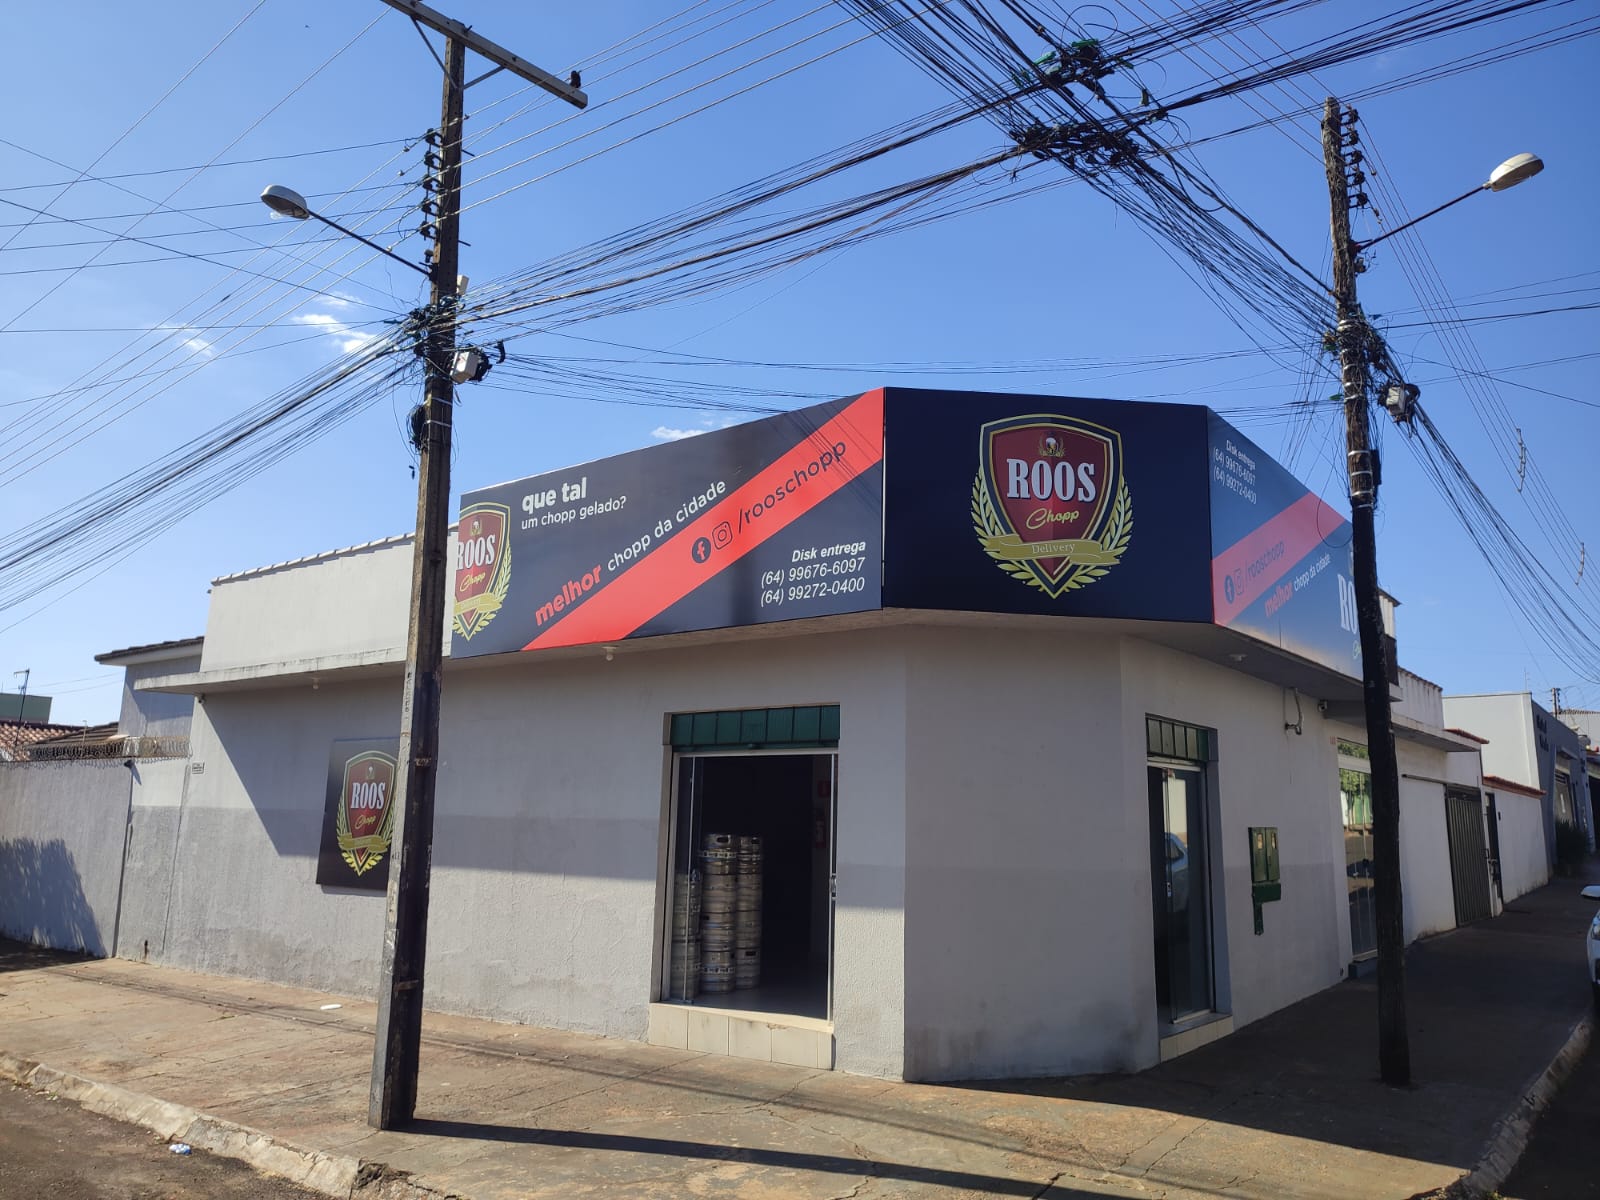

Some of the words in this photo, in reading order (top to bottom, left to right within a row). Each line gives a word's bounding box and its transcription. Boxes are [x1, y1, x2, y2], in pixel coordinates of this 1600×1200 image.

[522, 489, 557, 514] que
[561, 477, 587, 502] tal
[1006, 458, 1097, 502] ROOS
[521, 517, 538, 530] um
[541, 508, 576, 526] chopp
[579, 495, 627, 520] gelado?
[1026, 507, 1080, 530] Chopp
[535, 564, 602, 626] melhor
[607, 534, 651, 571] chopp
[654, 519, 673, 538] da
[676, 481, 726, 522] cidade
[791, 546, 817, 563] Disk
[820, 541, 867, 558] entrega
[1031, 542, 1076, 554] Delivery
[761, 569, 785, 589] (64)
[788, 557, 867, 582] 99676-6097
[760, 588, 785, 607] (64)
[788, 577, 865, 601] 99272-0400
[1264, 581, 1294, 619] melhor
[1293, 571, 1310, 592] chopp
[1337, 573, 1359, 635] RO
[350, 781, 386, 810] ROOS
